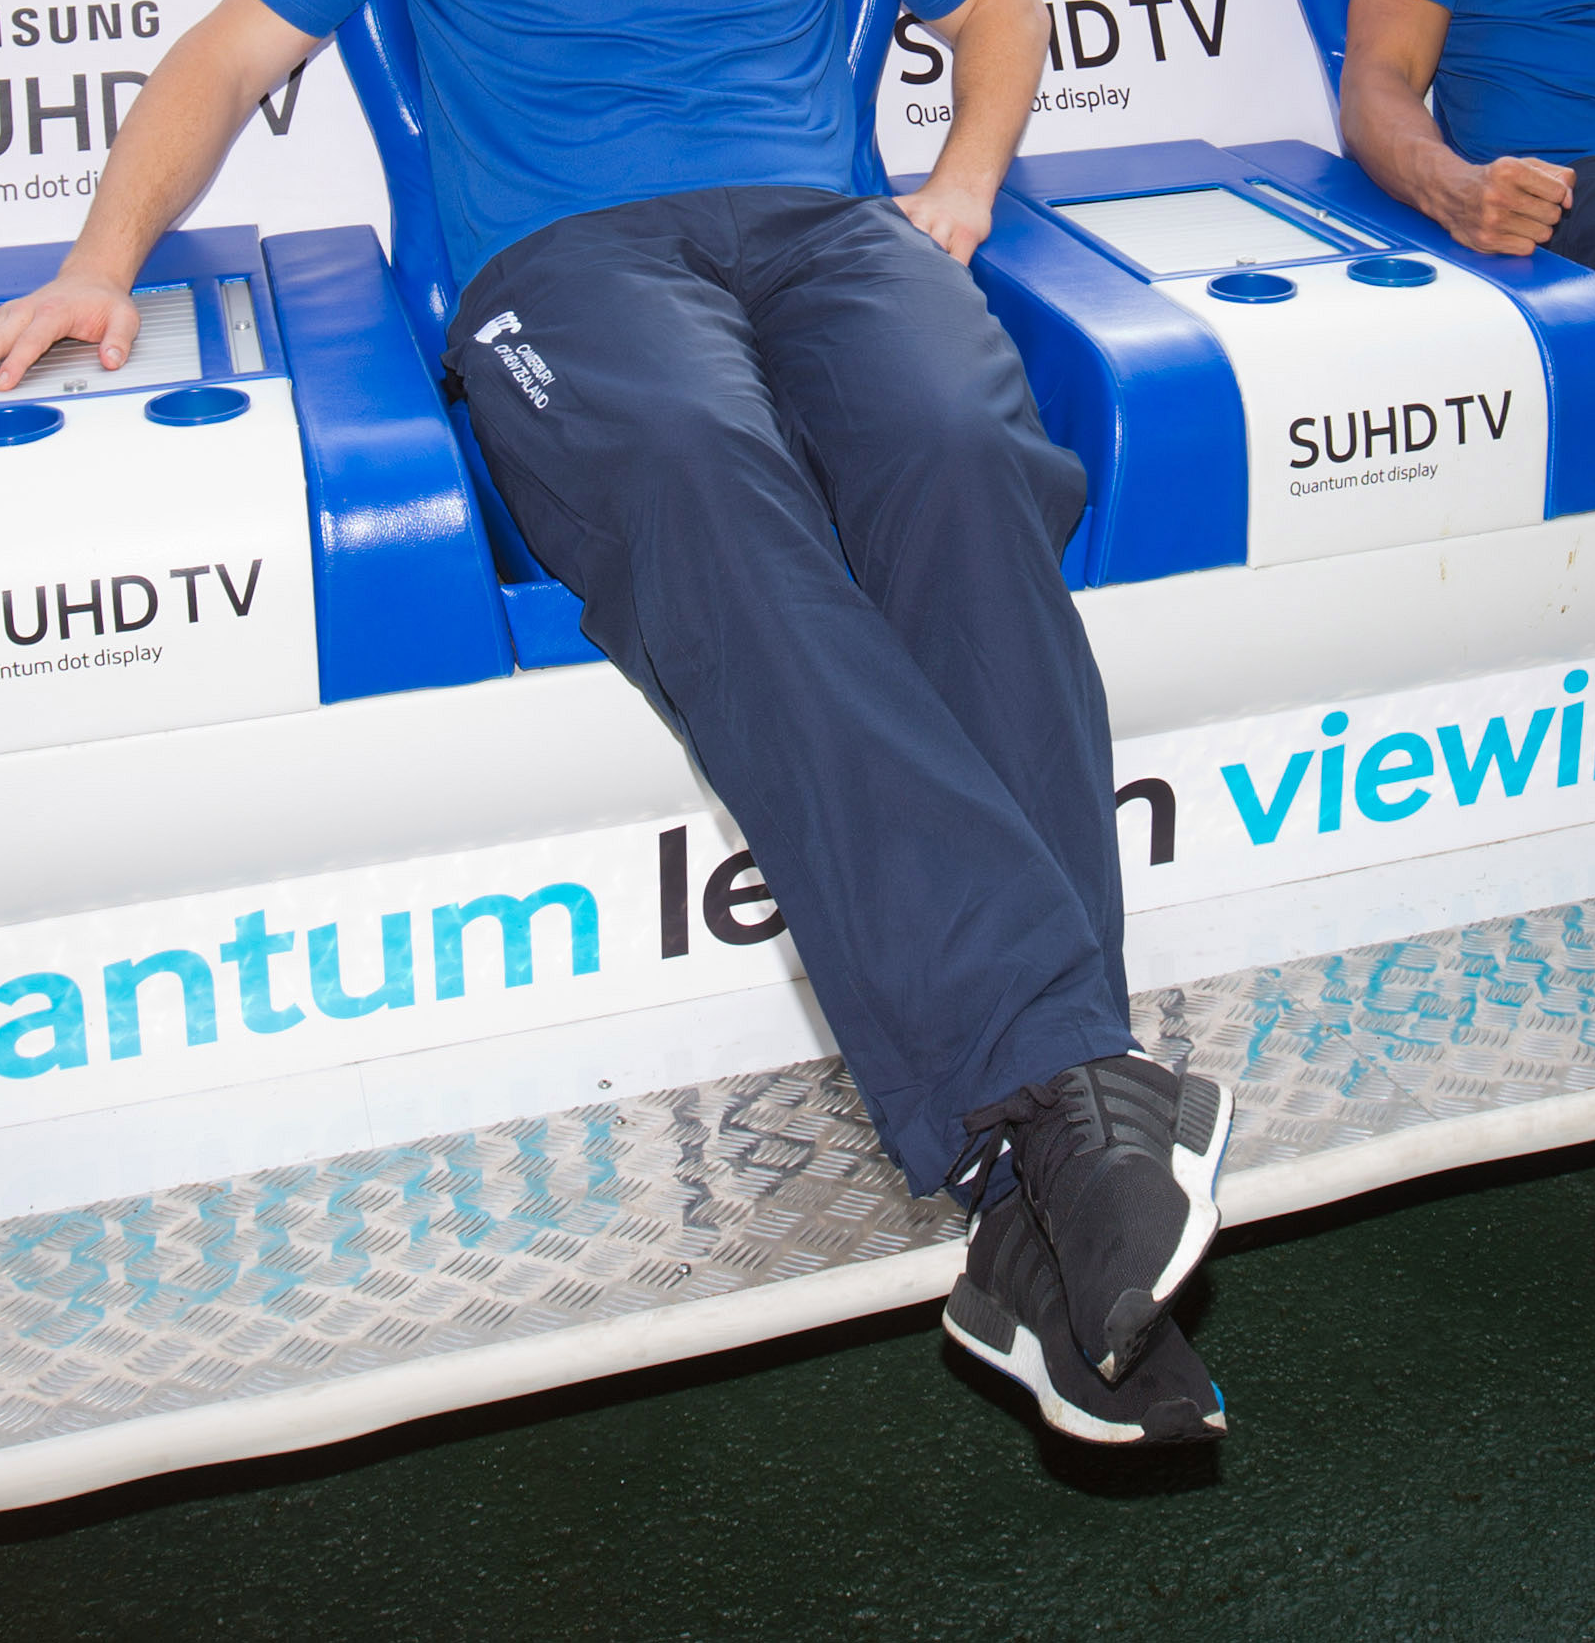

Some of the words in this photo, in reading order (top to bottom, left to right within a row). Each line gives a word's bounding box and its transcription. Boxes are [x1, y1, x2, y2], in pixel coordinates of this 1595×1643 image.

[1055, 84, 1132, 113] display
[24, 173, 70, 200] dot
[1289, 403, 1438, 470] SUHD
[1444, 389, 1512, 445] TV
[1290, 474, 1359, 497] Quantum
[1361, 469, 1385, 486] dot
[1387, 462, 1439, 483] display
[169, 558, 263, 624] TV
[57, 651, 91, 672] dot
[94, 644, 163, 668] display
